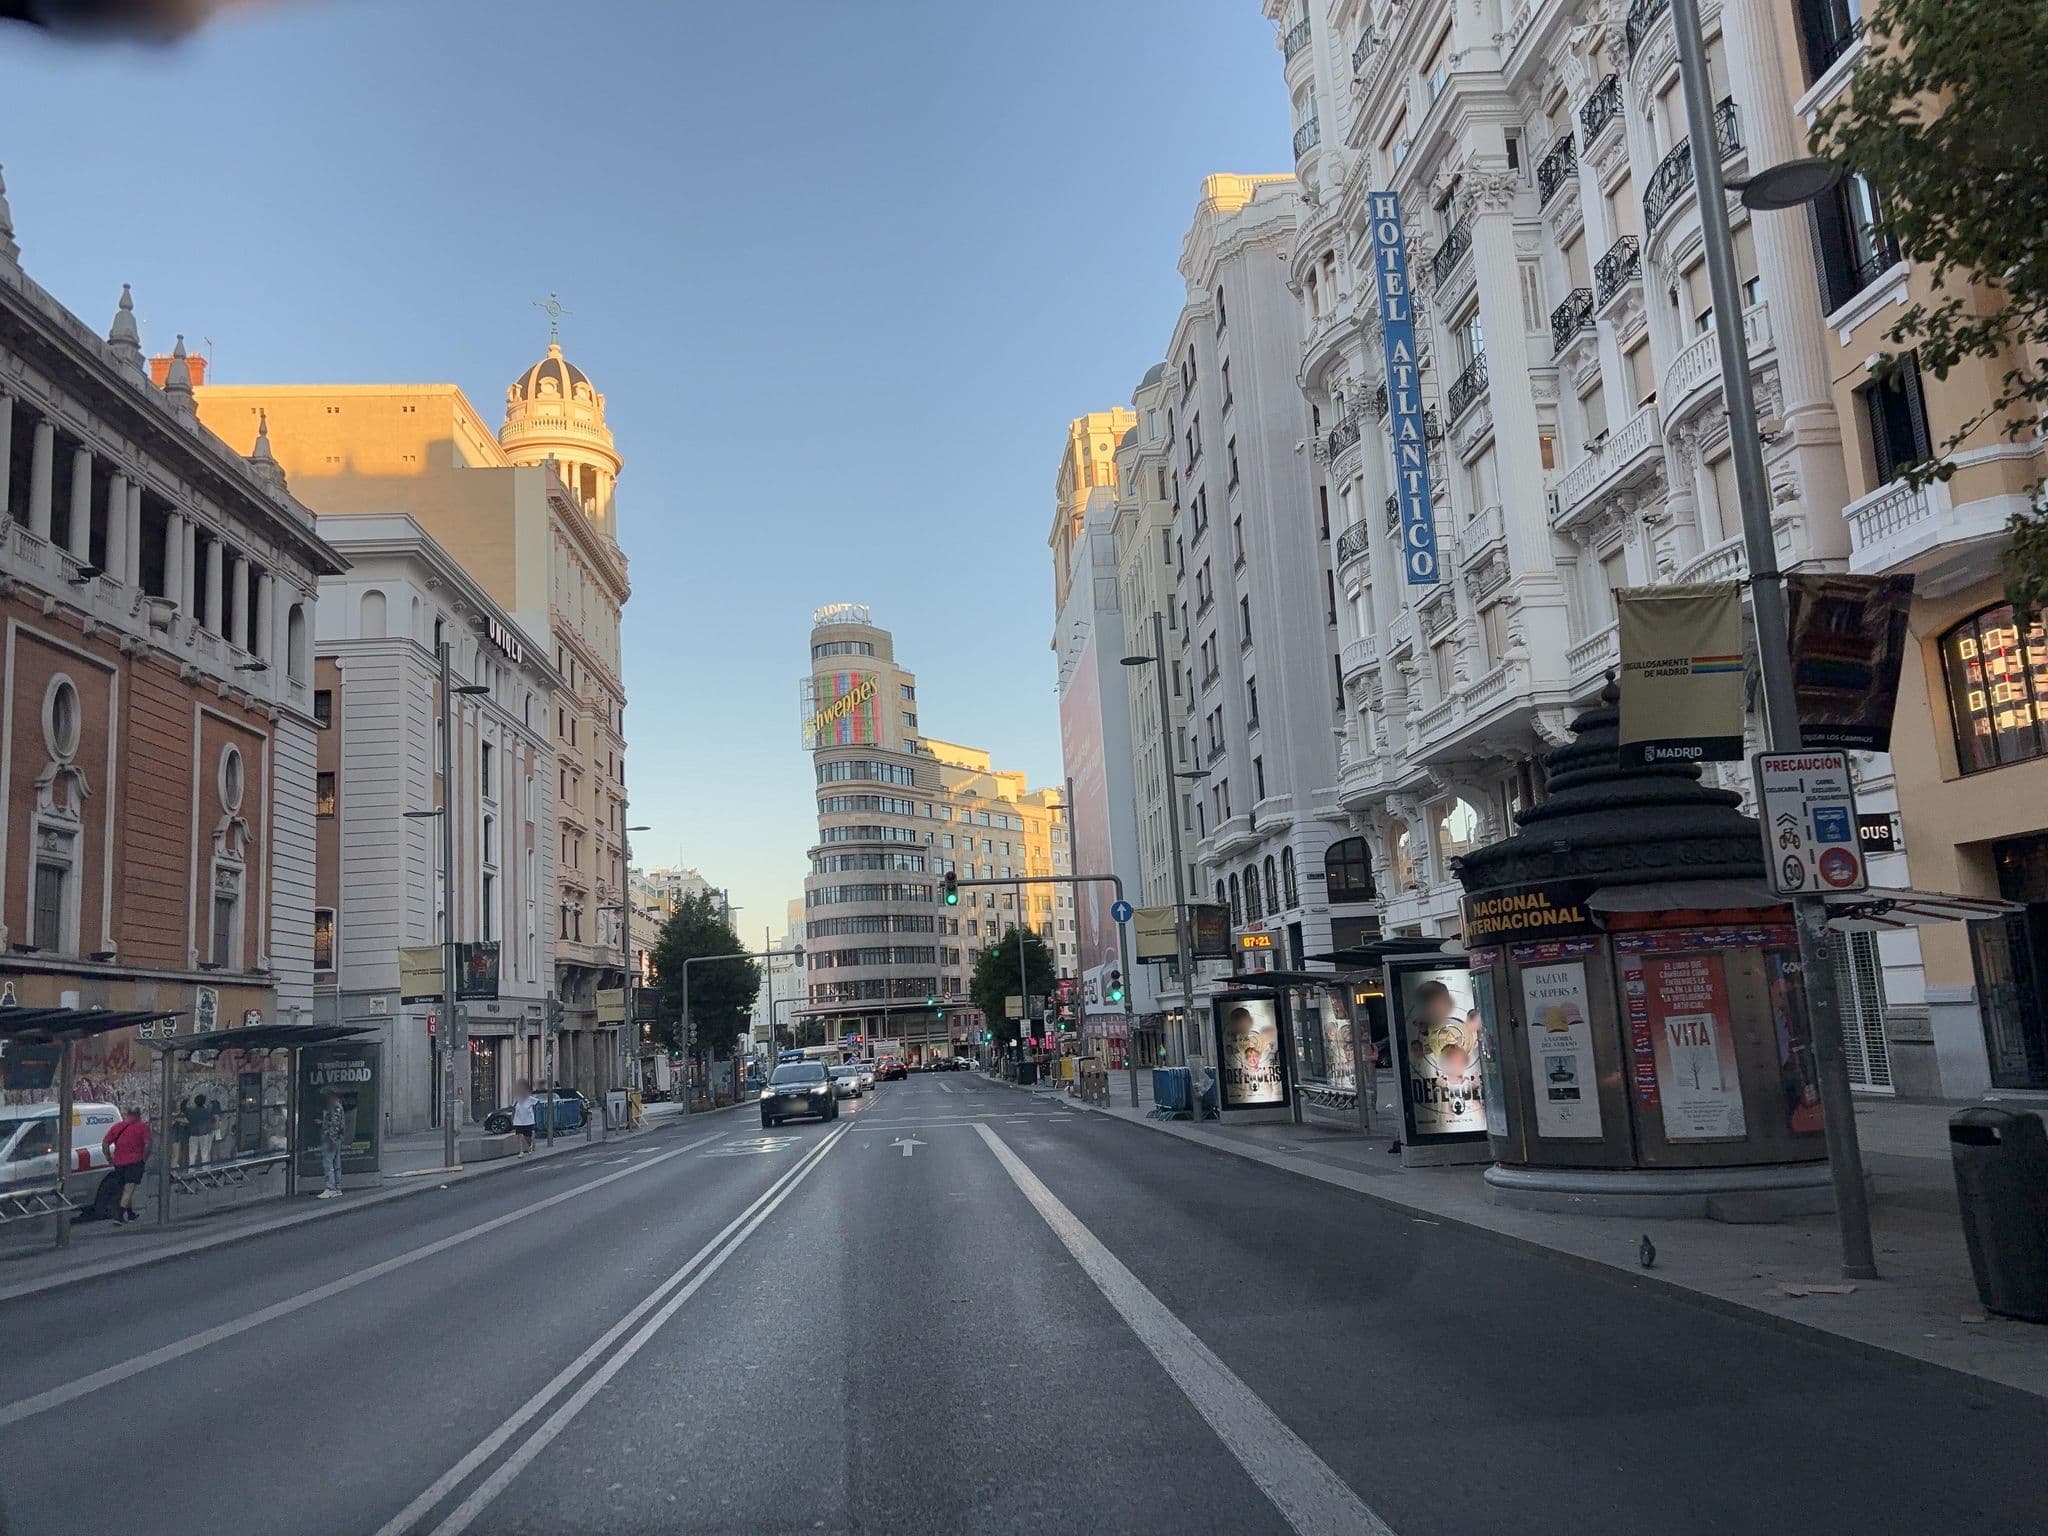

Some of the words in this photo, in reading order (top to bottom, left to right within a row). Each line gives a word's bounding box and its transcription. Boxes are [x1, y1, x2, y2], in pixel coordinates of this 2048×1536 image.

[1375, 196, 1406, 322] HOTEL
[1392, 340, 1434, 577] ATLANTICO
[490, 617, 522, 664] UNIQLO
[1644, 669, 1655, 678] DE
[1656, 667, 1689, 677] MADRID
[805, 676, 879, 735] hweppes
[1656, 746, 1703, 759] MADRID
[1473, 892, 1551, 918] NACIONAL
[1243, 936, 1271, 947] 07:21
[1529, 987, 1570, 999] SCALPERS
[1669, 1021, 1711, 1046] VITA
[310, 1071, 324, 1085] LA
[326, 1068, 372, 1083] VERDAD
